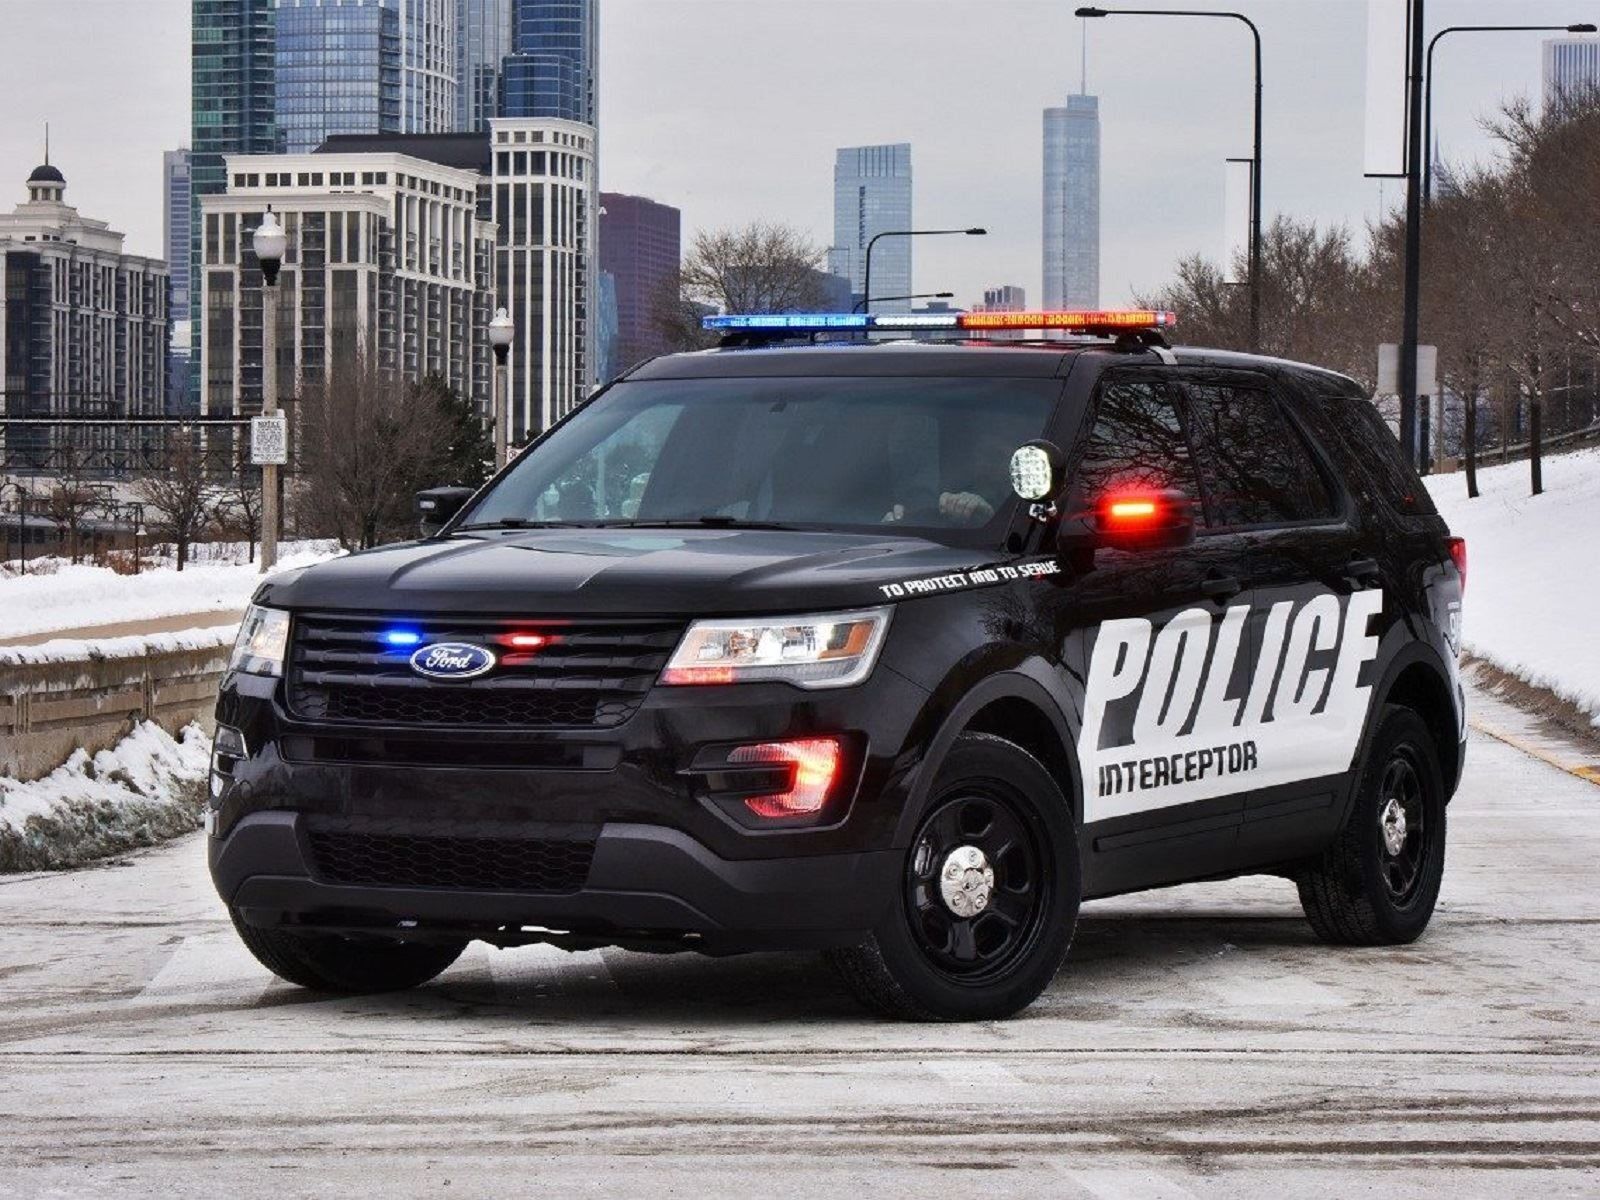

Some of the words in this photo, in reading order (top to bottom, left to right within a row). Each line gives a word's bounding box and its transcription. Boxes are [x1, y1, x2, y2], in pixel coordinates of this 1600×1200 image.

[879, 584, 904, 599] TO
[904, 573, 968, 594] PROTECT
[969, 570, 998, 584] AND
[998, 565, 1018, 578] TO
[1018, 561, 1061, 577] SERVE
[425, 647, 473, 668] Ford
[1081, 588, 1383, 751] POLICE
[1098, 740, 1258, 797] INTERCEPTOR
